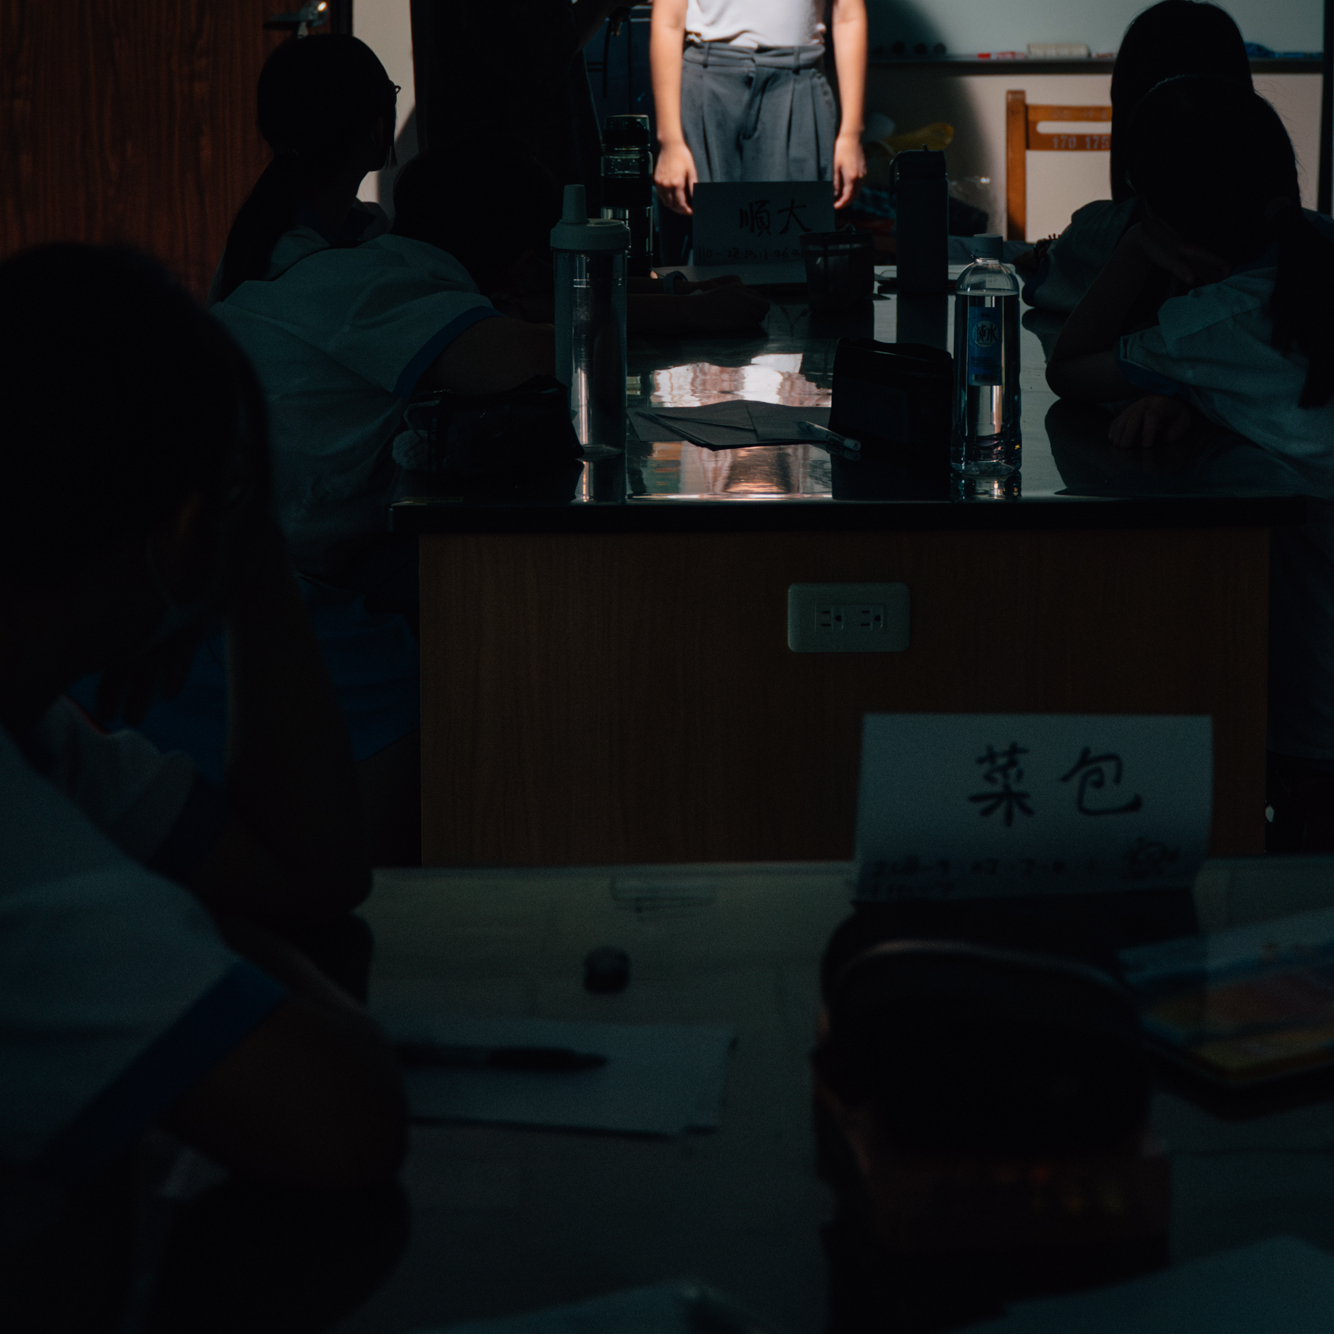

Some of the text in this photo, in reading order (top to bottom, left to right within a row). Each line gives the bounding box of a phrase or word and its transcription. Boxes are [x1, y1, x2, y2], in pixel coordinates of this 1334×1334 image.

[1052, 135, 1110, 149] 170 175
[739, 199, 812, 237] 順大
[969, 742, 1142, 828] 菜包
